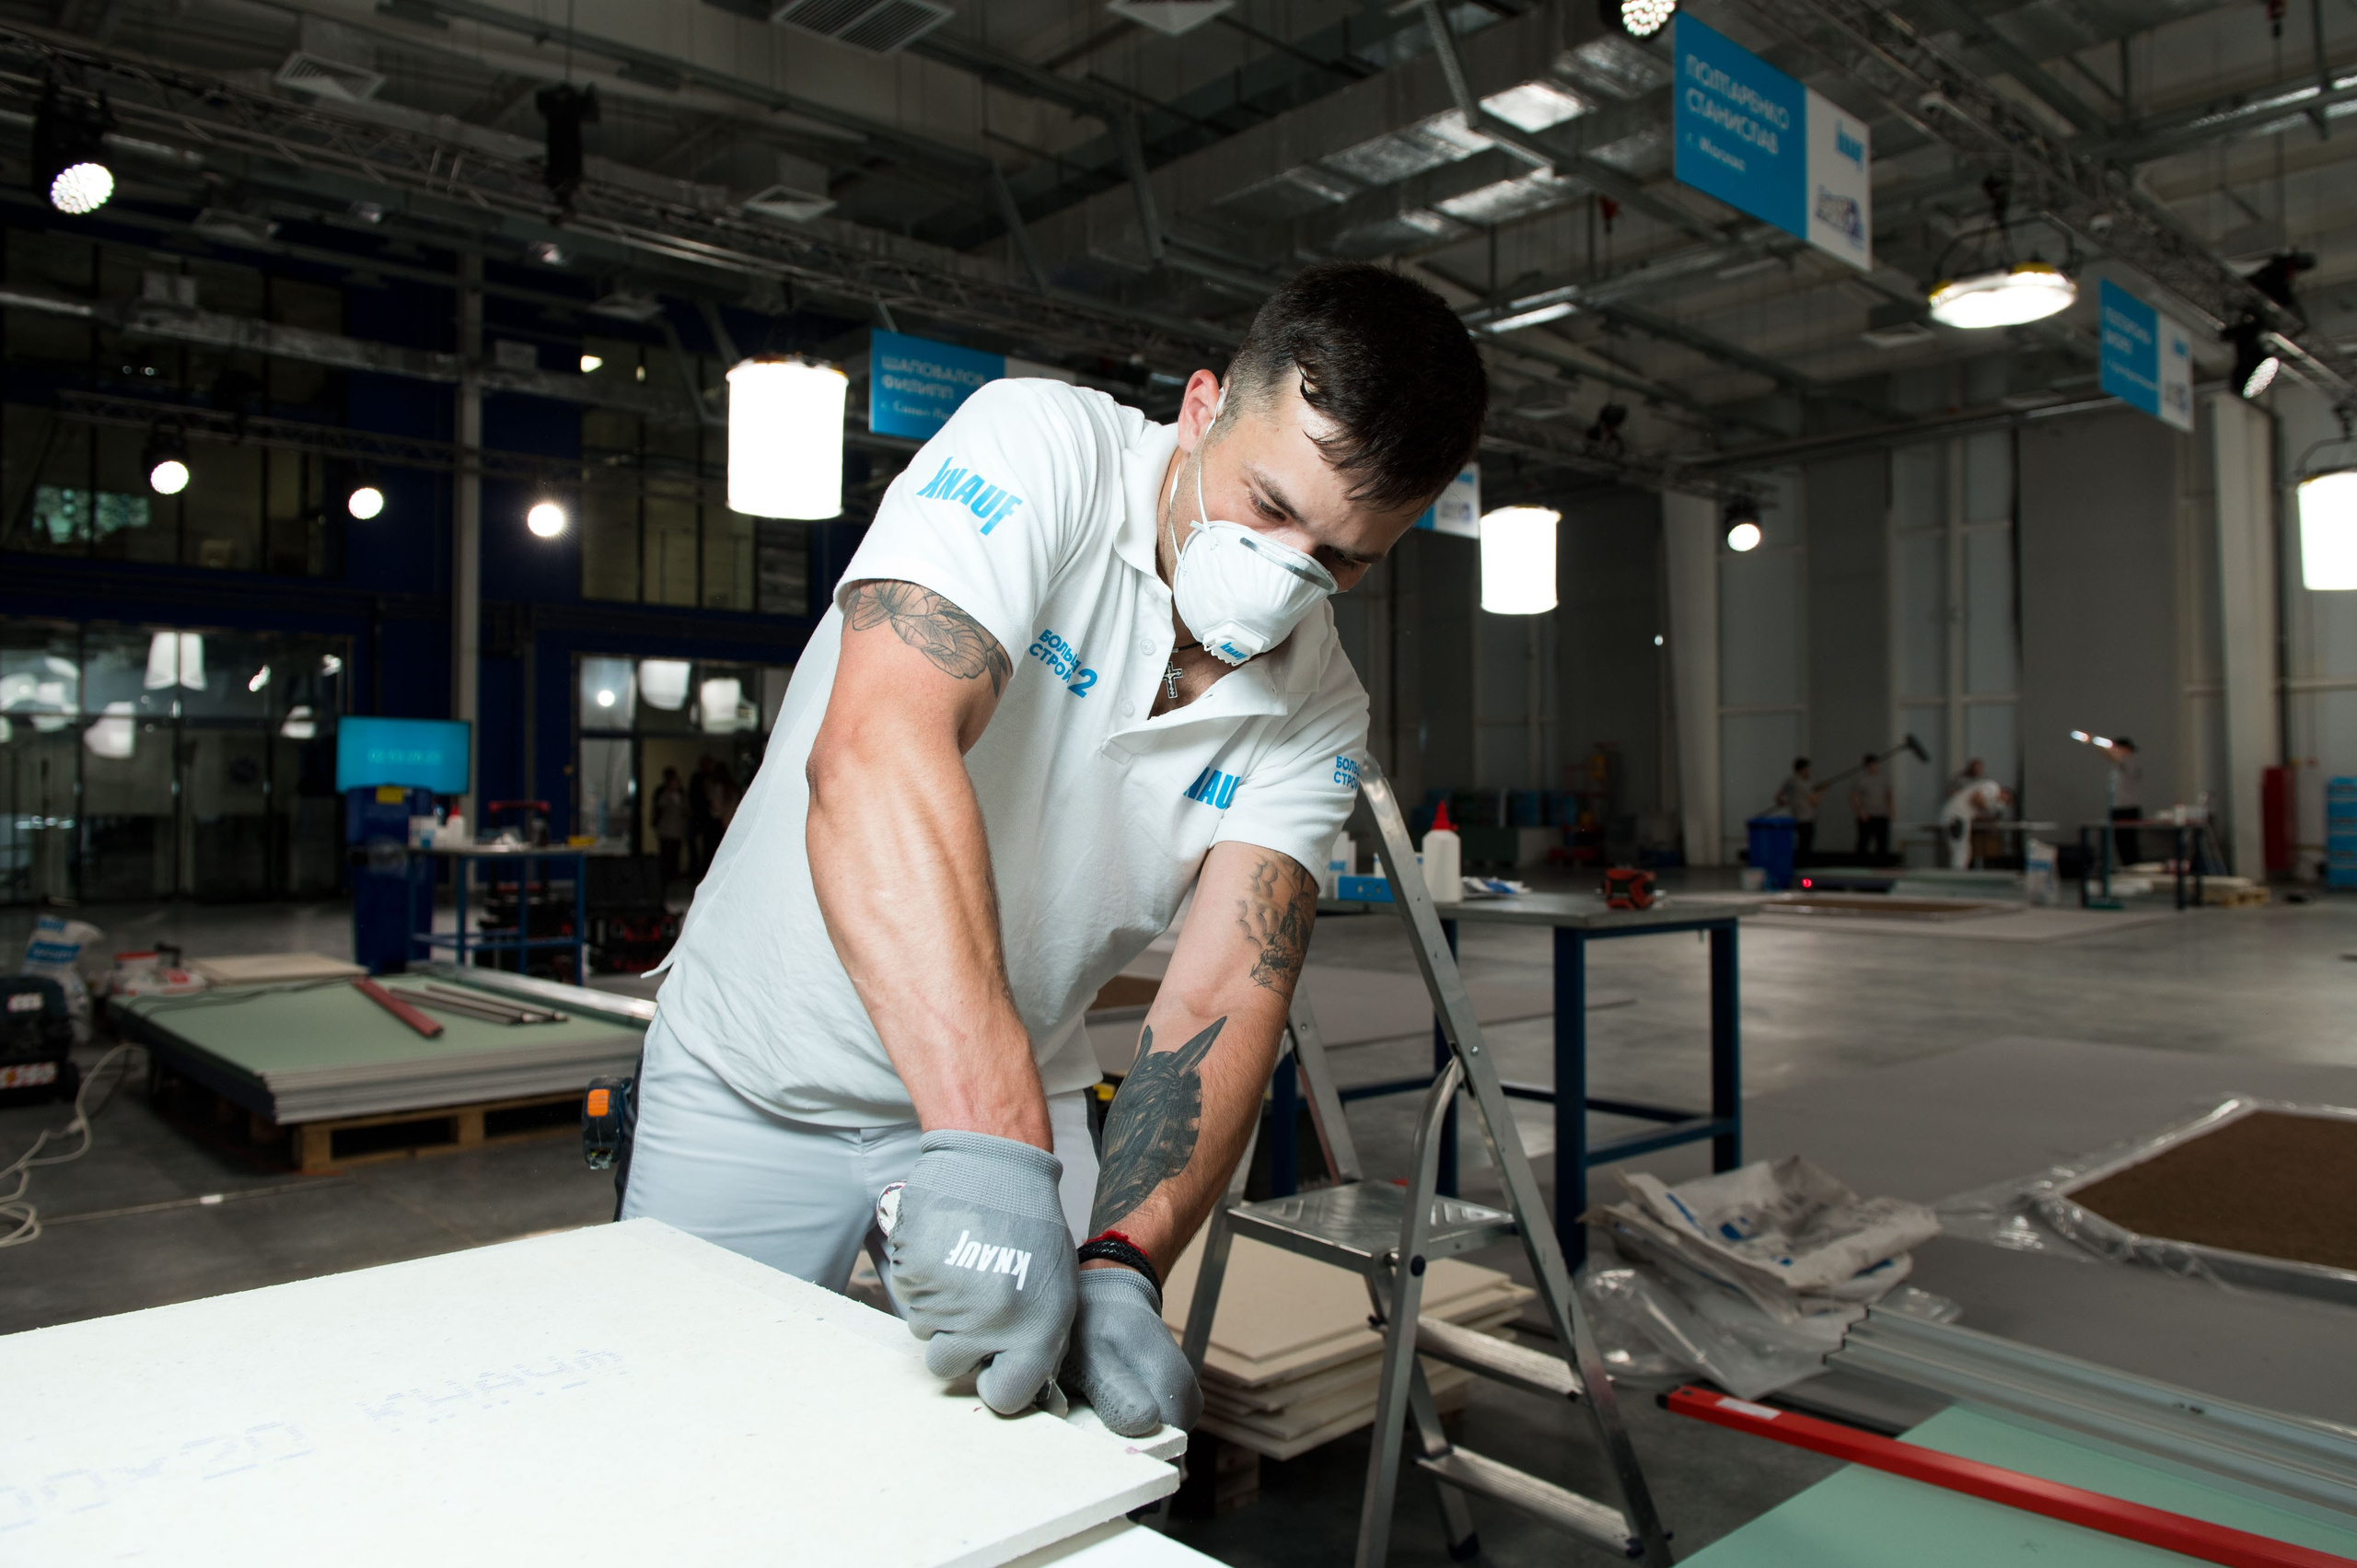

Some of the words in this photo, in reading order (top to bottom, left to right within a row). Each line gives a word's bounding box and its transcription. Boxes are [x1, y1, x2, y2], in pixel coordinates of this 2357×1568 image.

[916, 457, 1023, 536] KNAUF
[1220, 642, 1248, 660] KNAUF
[1067, 668, 1097, 698] 2
[945, 1230, 1032, 1291] KNAUF
